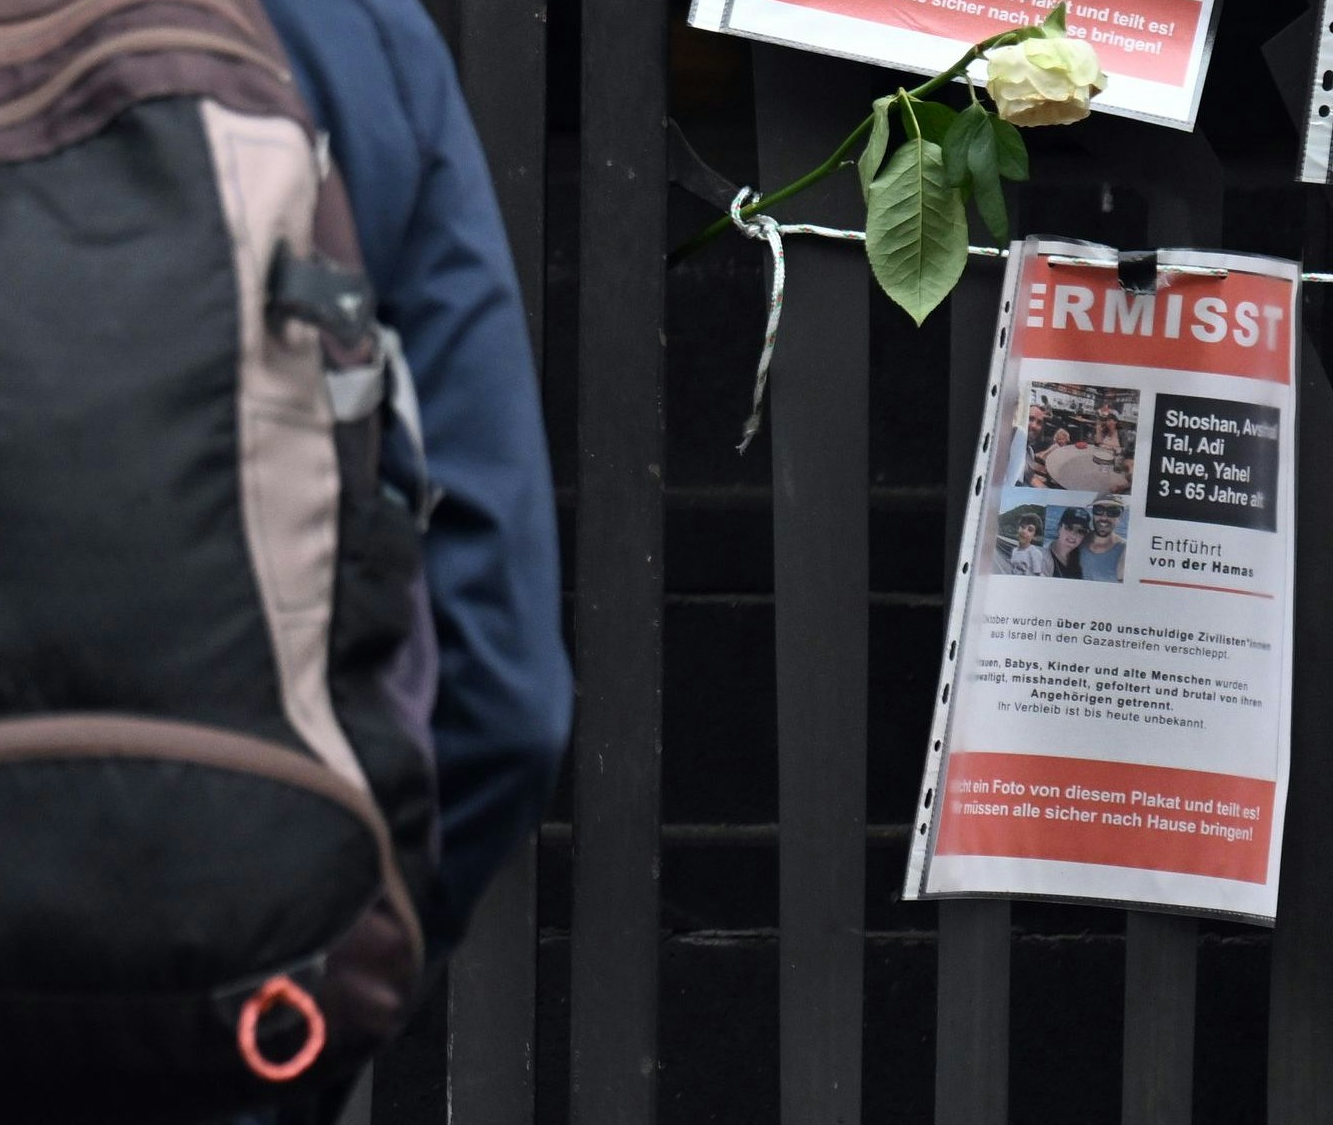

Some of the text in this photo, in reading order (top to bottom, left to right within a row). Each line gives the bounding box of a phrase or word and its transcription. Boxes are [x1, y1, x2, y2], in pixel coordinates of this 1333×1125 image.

[1027, 284, 1282, 351] ERMISST
[1164, 408, 1241, 437] Shoshan,
[1162, 431, 1225, 456] Tal, Adi
[1160, 455, 1251, 483] Nave, Yahel
[1157, 478, 1170, 497] 3
[1183, 481, 1206, 501] 65
[1207, 484, 1249, 506] Jahre
[1150, 534, 1222, 557] Entführt
[1148, 556, 1254, 578] von der Hamas
